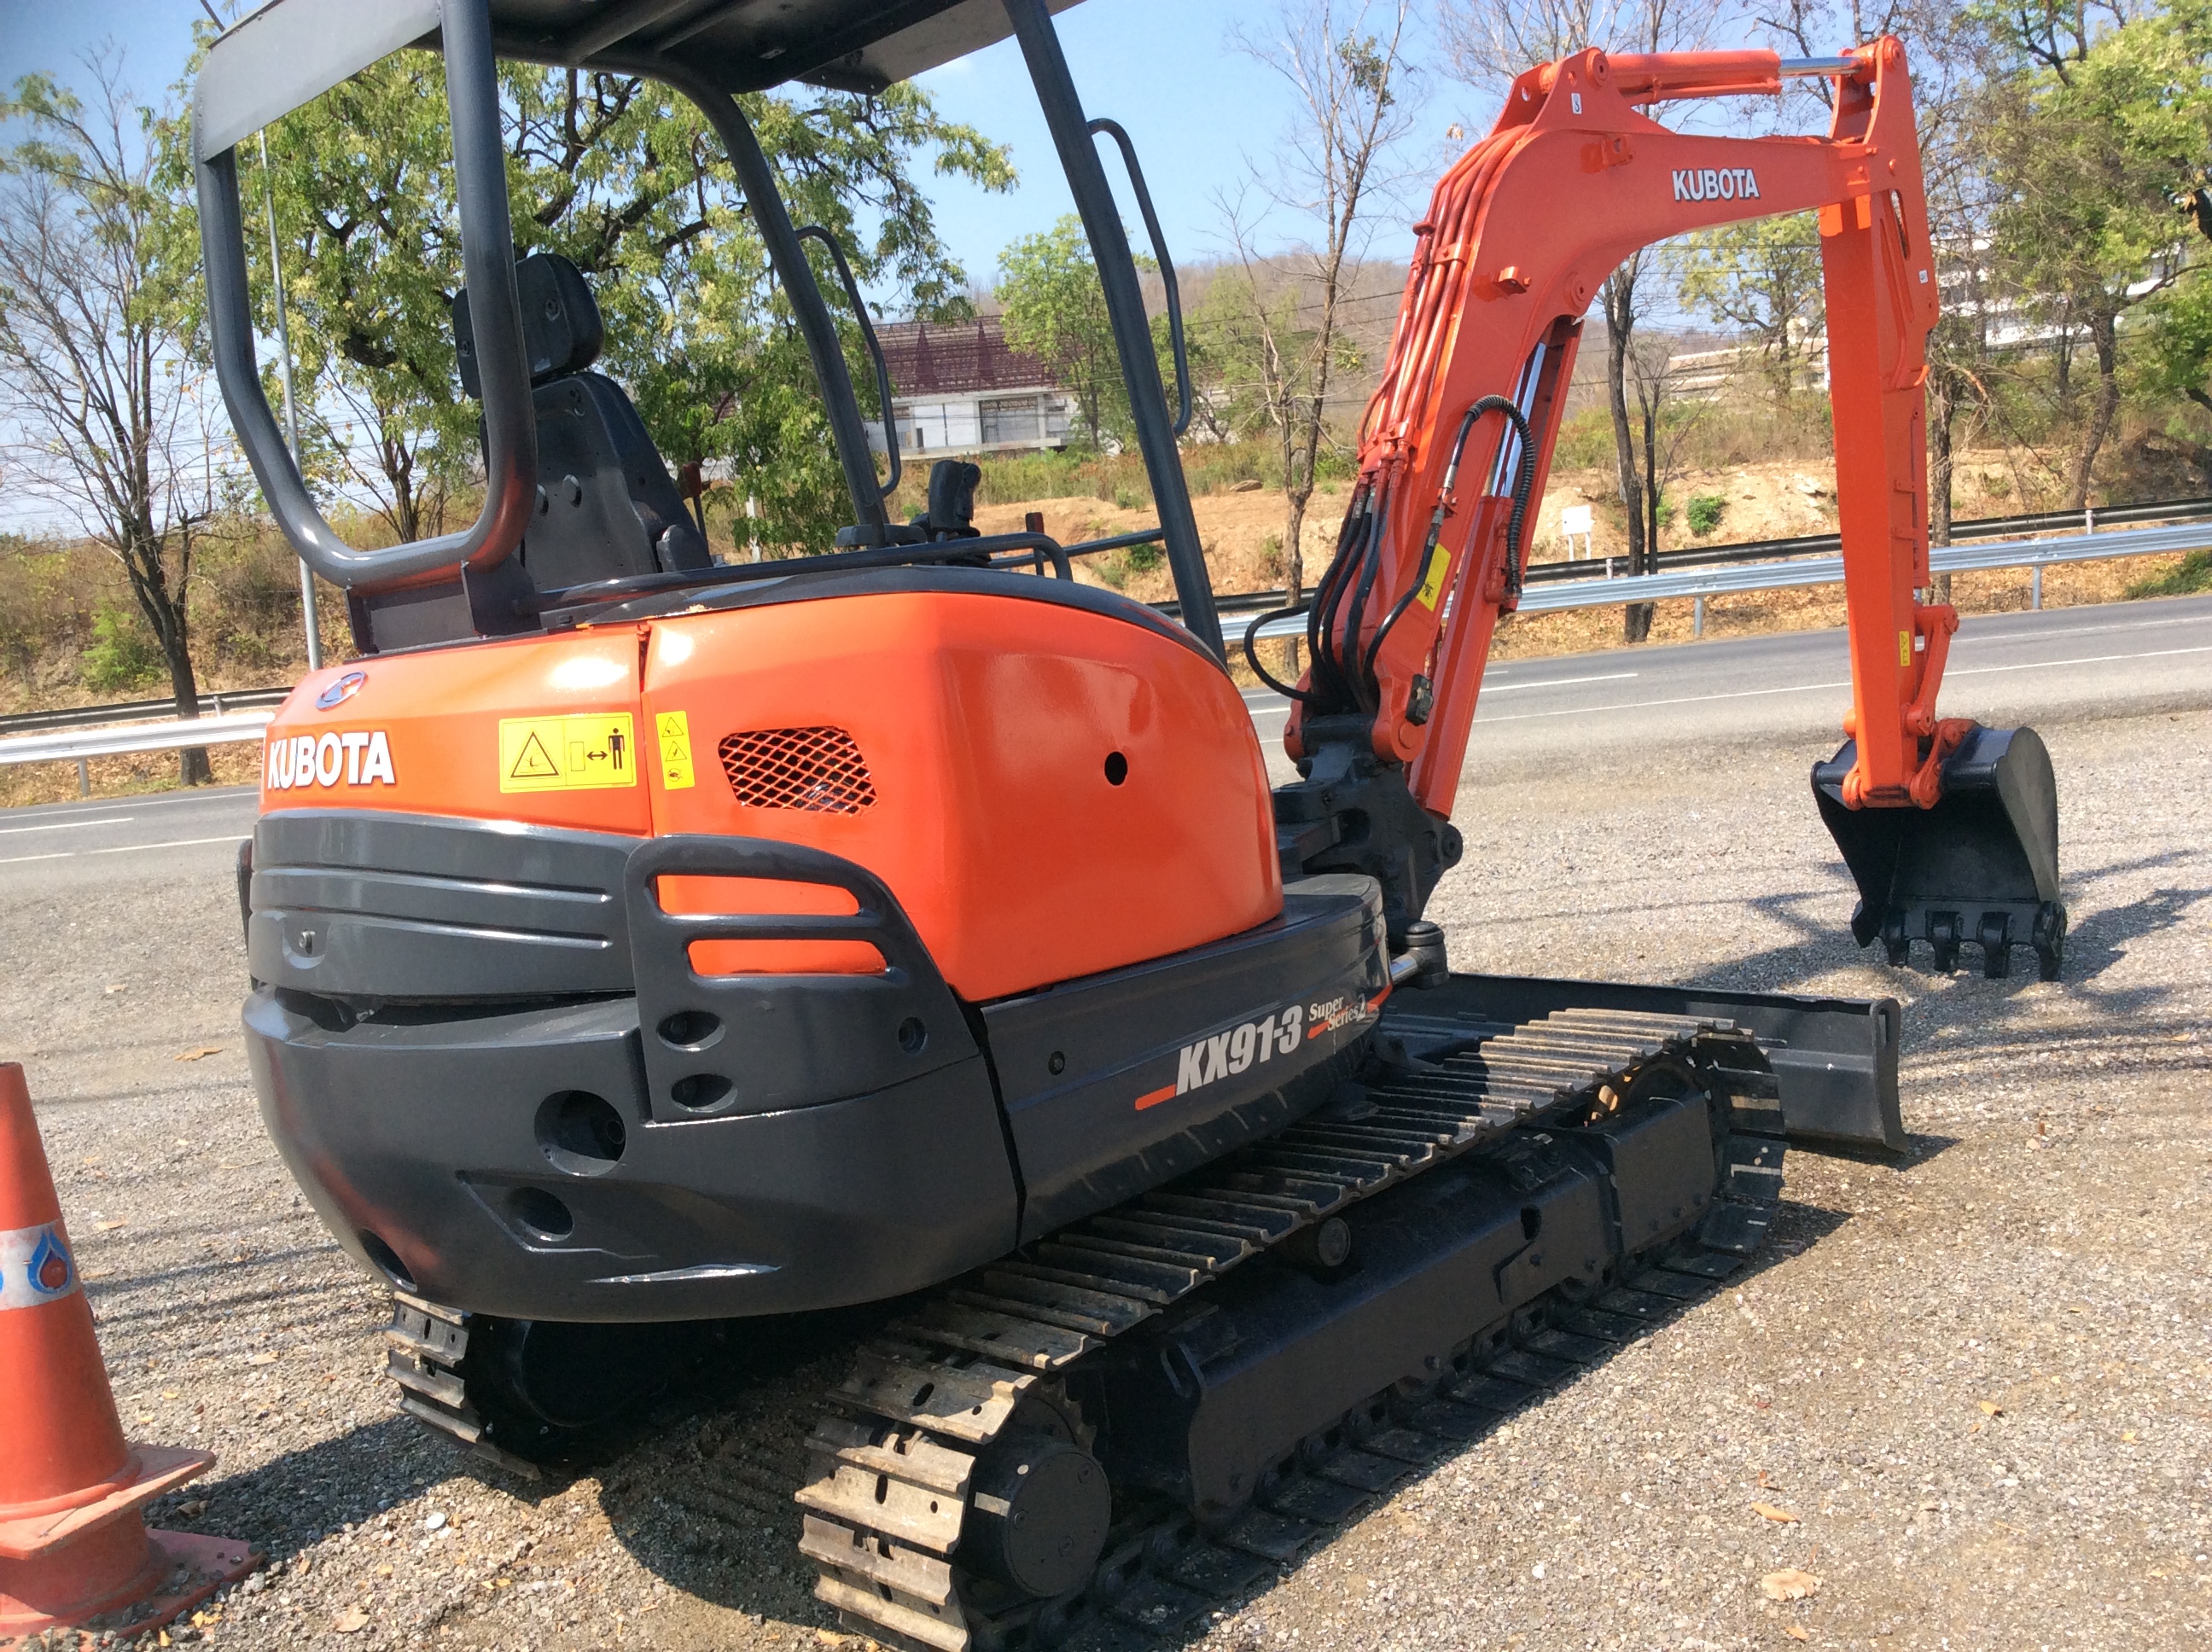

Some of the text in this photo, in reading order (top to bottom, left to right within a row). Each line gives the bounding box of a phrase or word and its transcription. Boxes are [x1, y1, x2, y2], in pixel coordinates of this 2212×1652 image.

[1672, 168, 1760, 201] KUBOTA
[267, 731, 396, 789] KUBOTA
[1308, 996, 1344, 1021] Super
[1176, 1004, 1303, 1096] KX91-3
